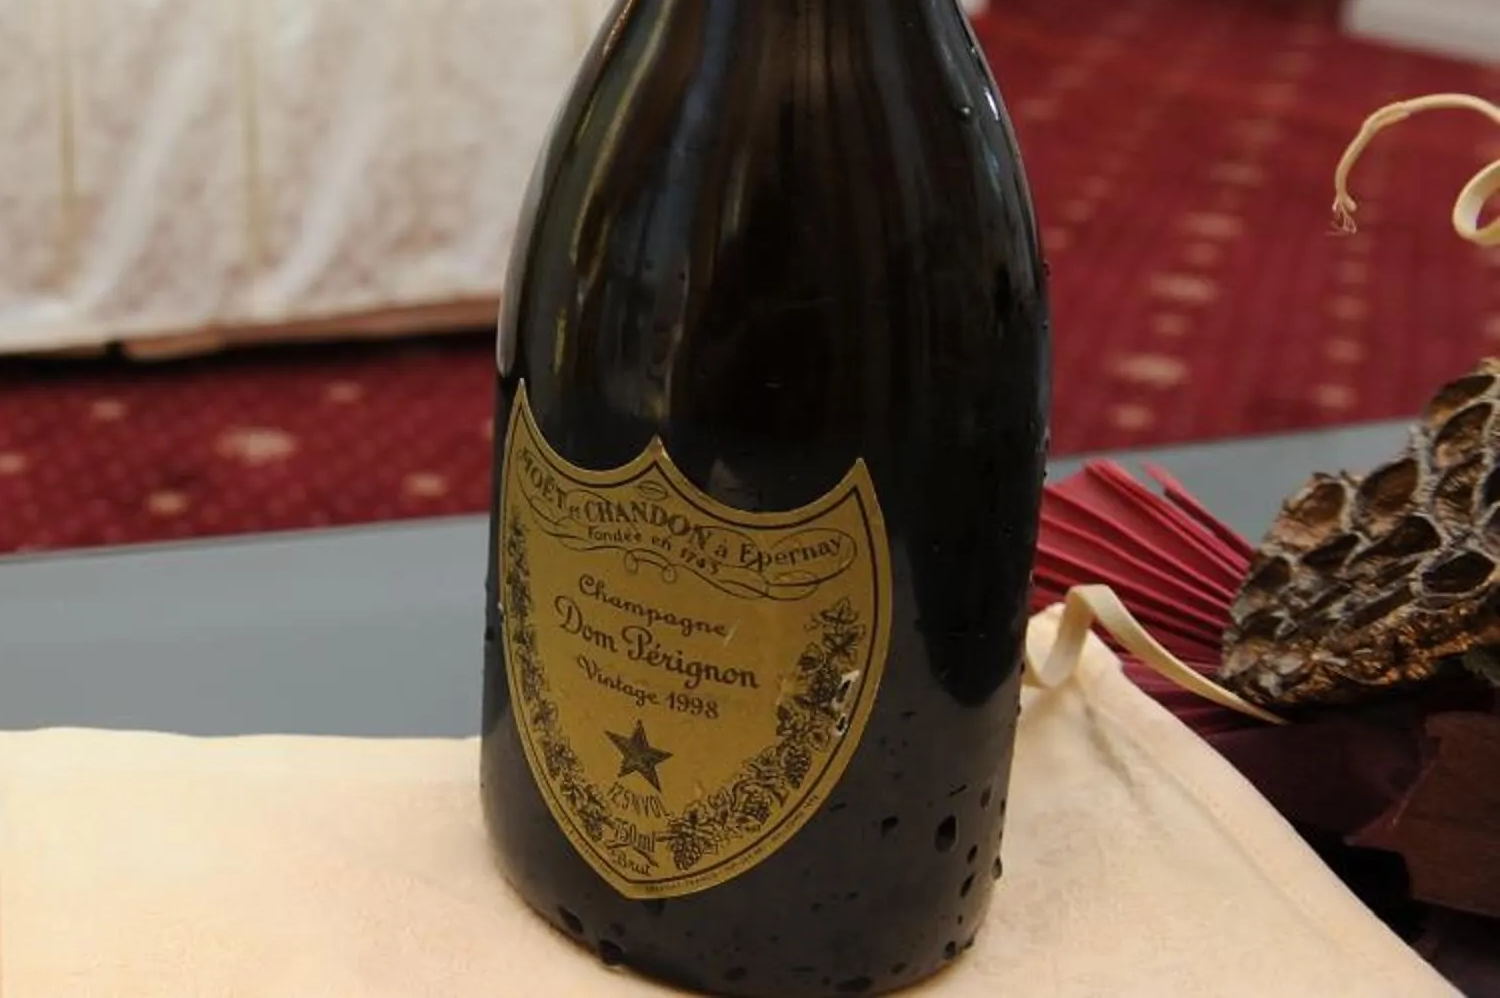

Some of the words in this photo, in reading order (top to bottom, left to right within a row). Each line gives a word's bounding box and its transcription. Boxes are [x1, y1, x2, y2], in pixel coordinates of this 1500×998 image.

[584, 501, 712, 550] CHANDON
[651, 536, 672, 551] en
[579, 573, 728, 637] Champagne
[554, 595, 618, 653] Dom
[622, 625, 759, 690] Pérignon
[577, 654, 659, 707] Vintage
[666, 691, 719, 719] 1998
